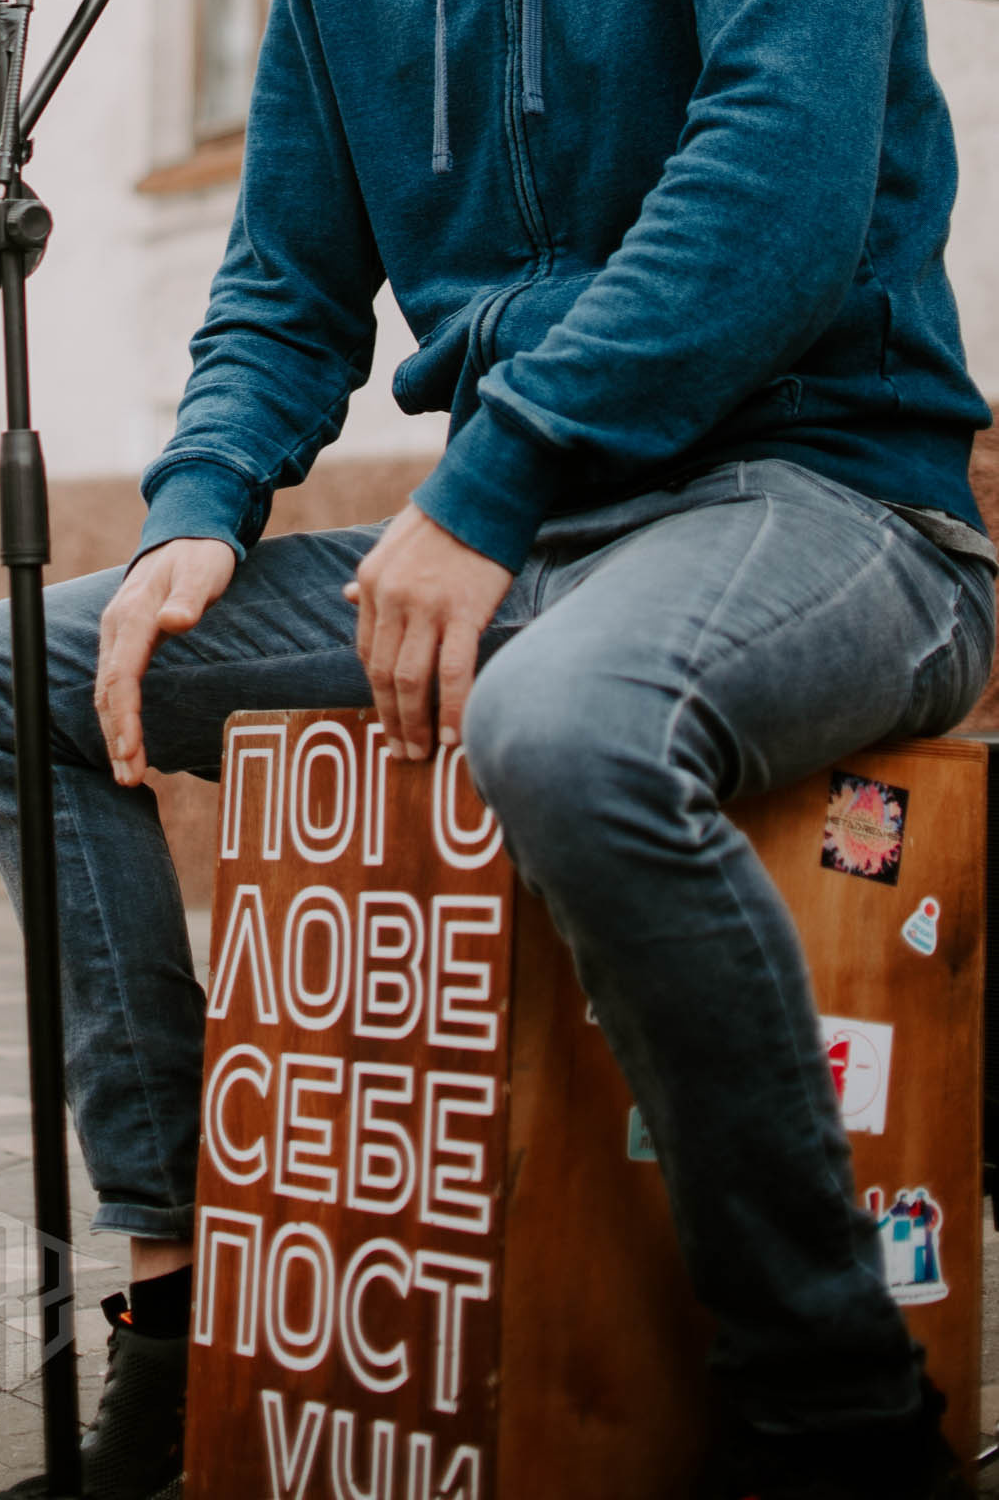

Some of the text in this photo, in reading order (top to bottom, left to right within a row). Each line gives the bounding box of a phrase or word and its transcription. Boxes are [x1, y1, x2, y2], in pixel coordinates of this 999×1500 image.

[207, 884, 501, 1051] ЛОВЕ
[205, 1043, 495, 1234] СЕБЕ
[194, 1205, 491, 1414] ПОСТ
